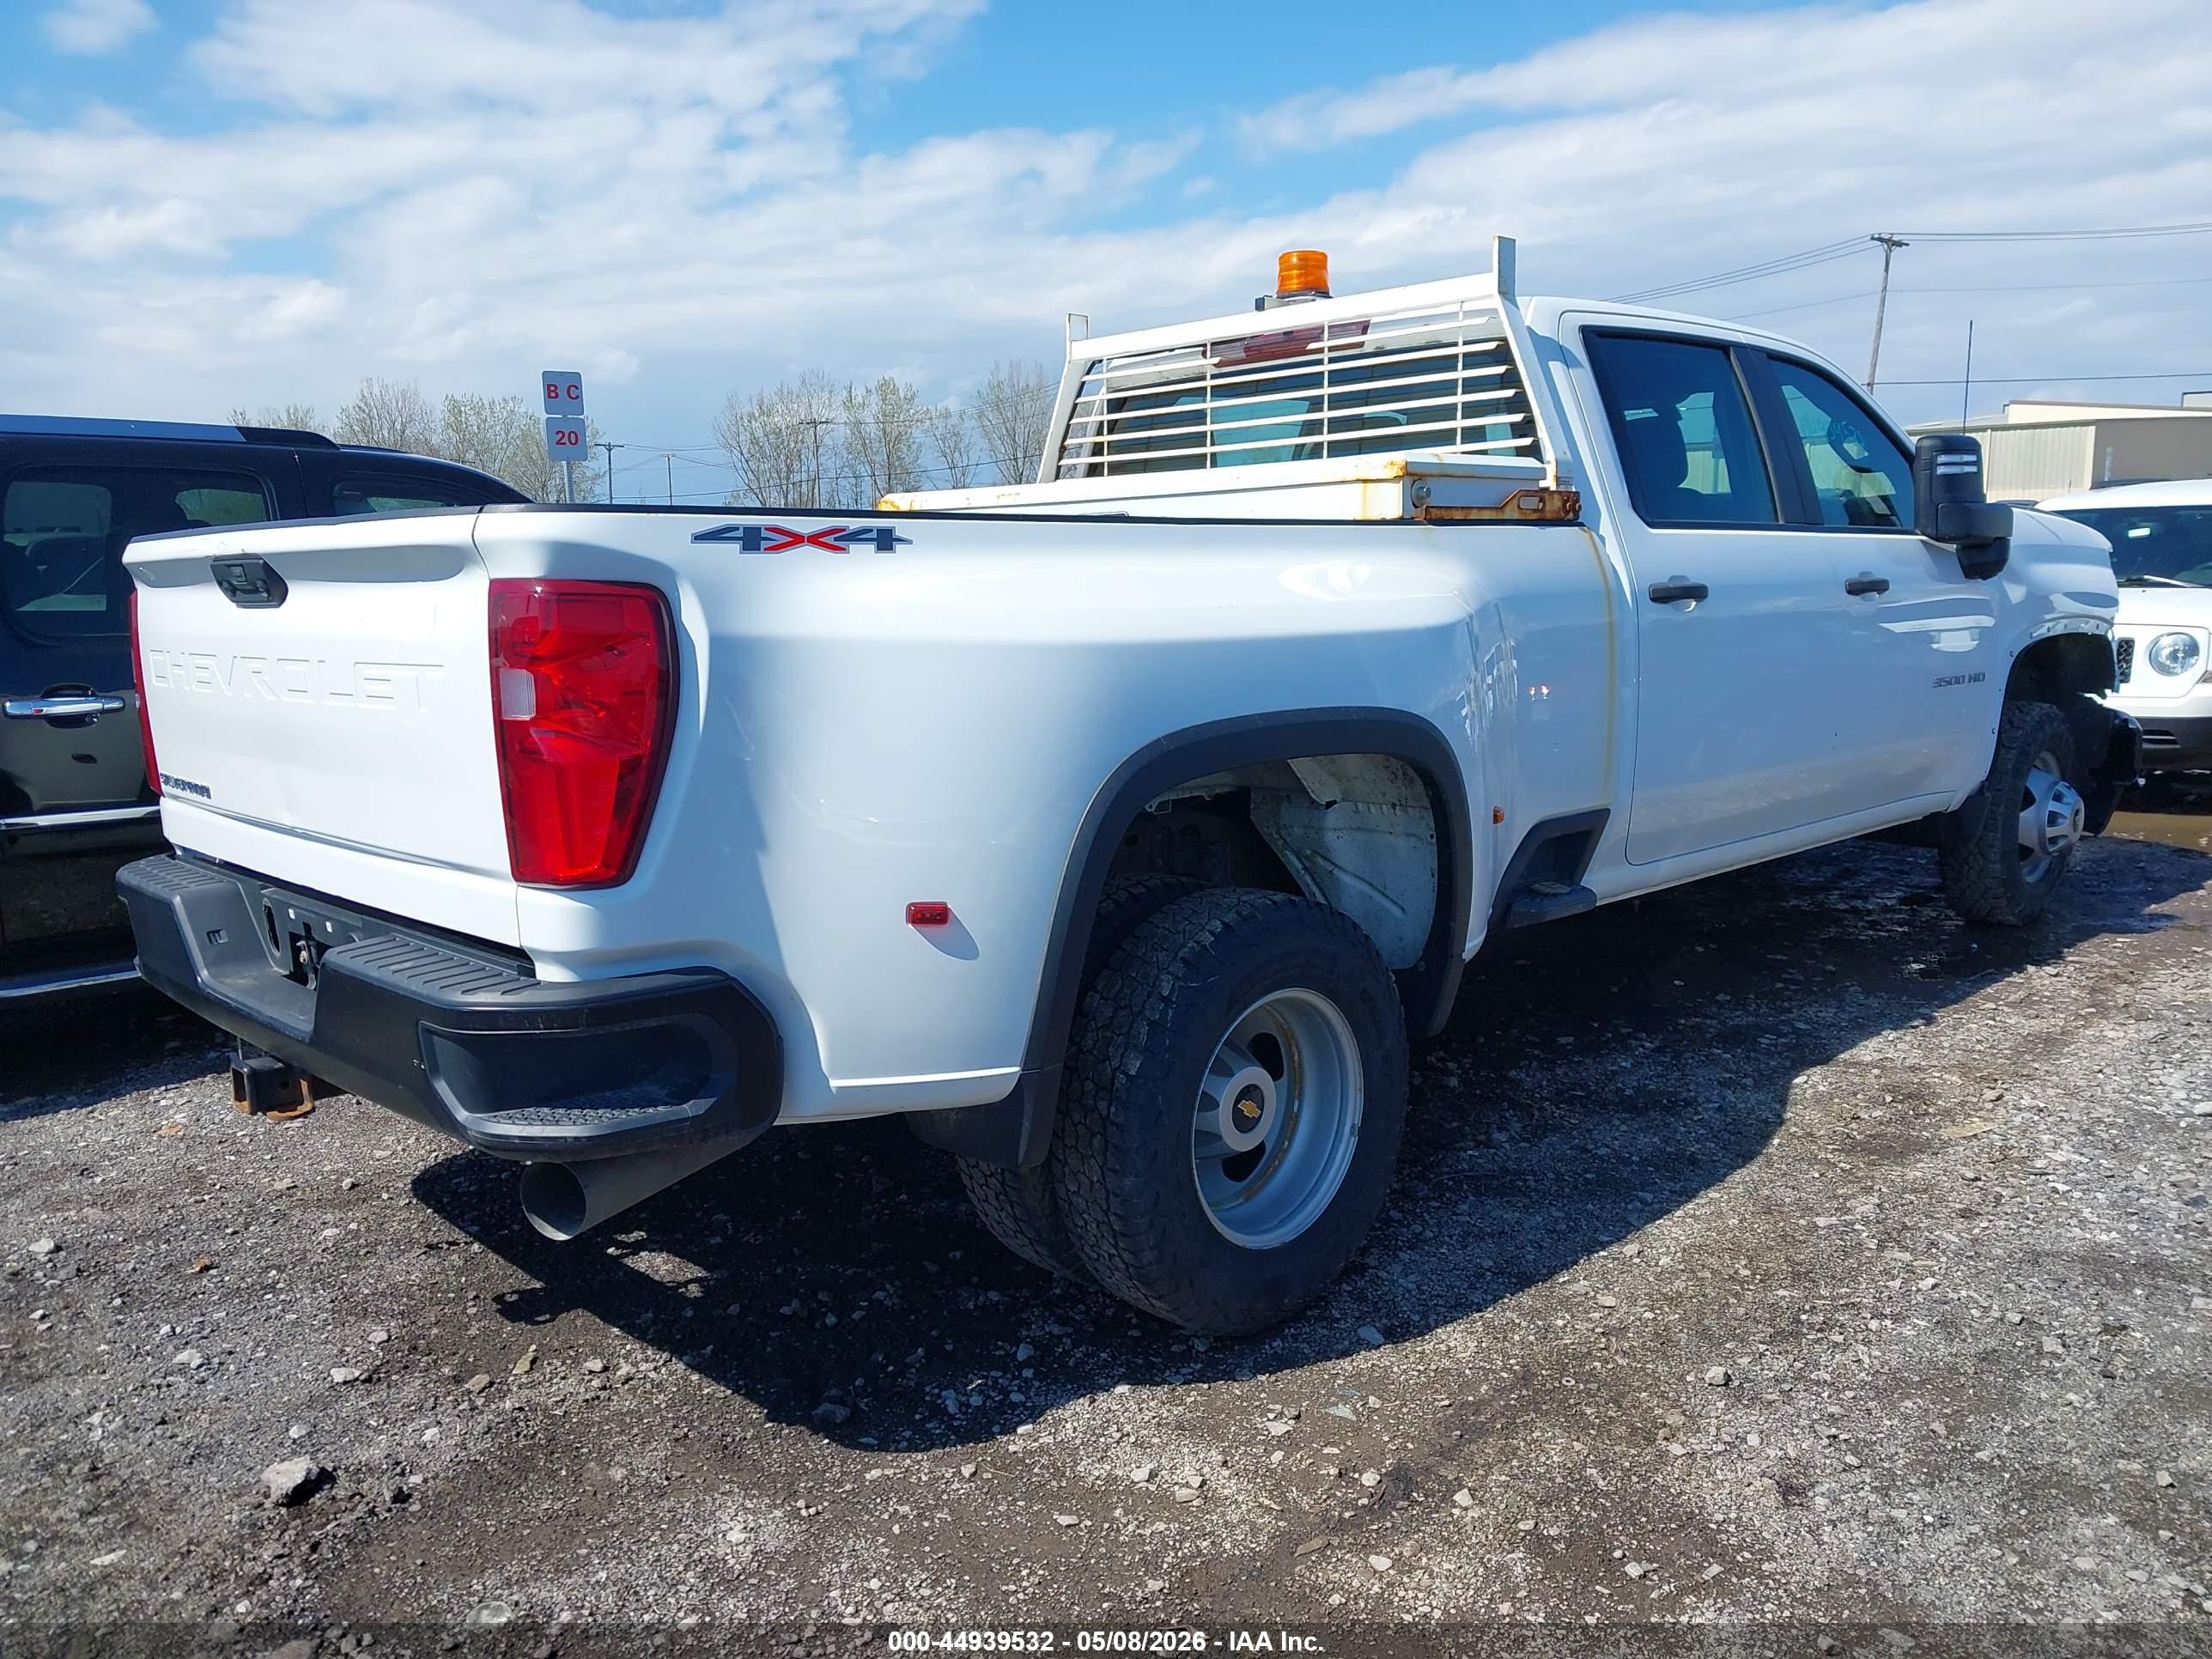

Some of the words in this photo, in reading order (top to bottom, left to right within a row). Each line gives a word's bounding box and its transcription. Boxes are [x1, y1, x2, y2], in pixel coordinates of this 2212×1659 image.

[546, 383, 560, 399] B
[567, 384, 580, 400] C
[556, 430, 580, 446] 20
[149, 649, 445, 714] CHEVROLET
[1932, 675, 1966, 689] 3500
[1967, 672, 1986, 684] HD
